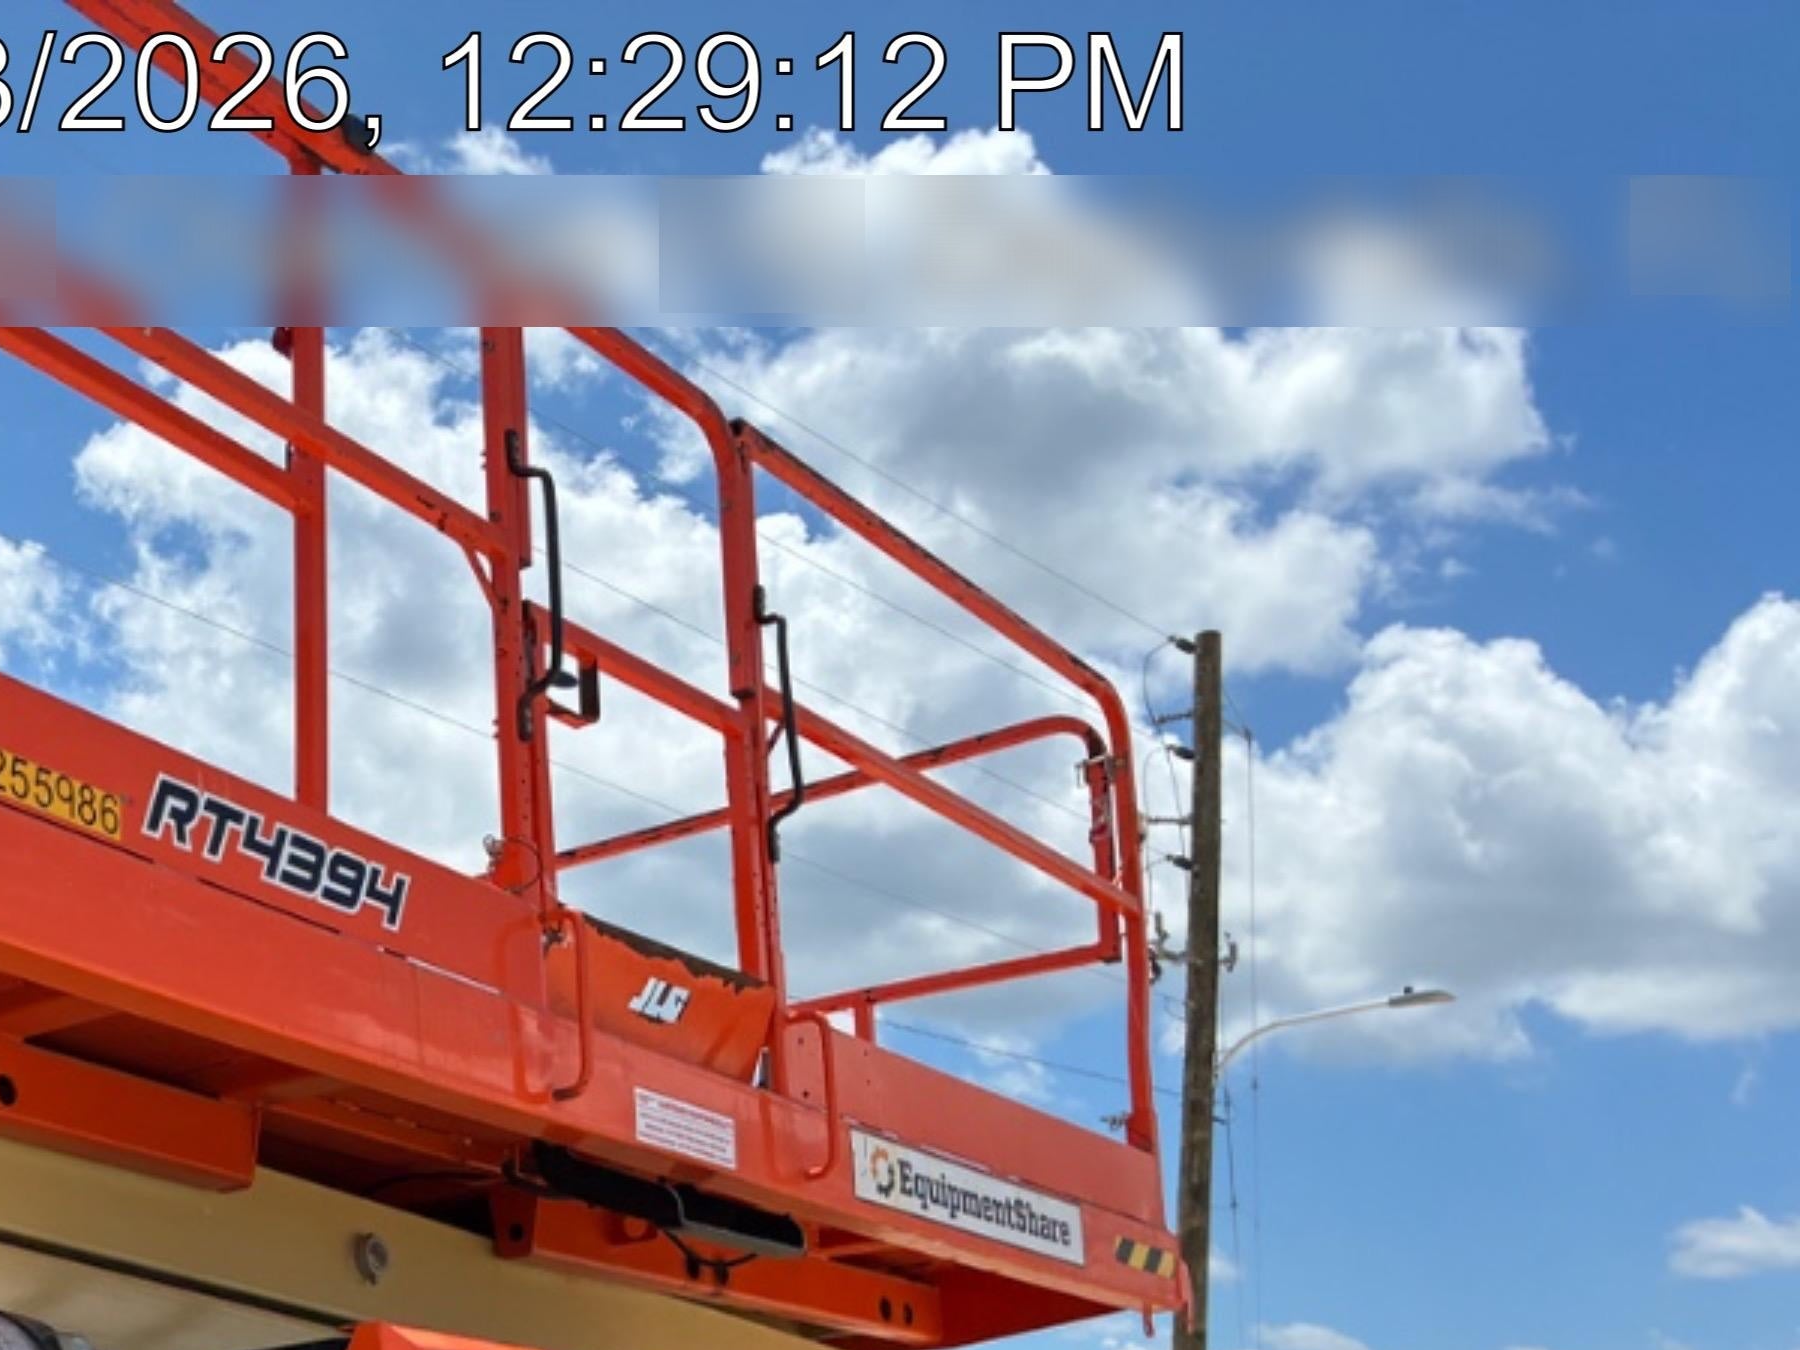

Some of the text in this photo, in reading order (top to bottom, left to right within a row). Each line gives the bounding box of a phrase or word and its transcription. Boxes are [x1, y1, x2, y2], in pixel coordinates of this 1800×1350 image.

[142, 772, 410, 931] RT4394
[627, 976, 691, 1025] JLG
[897, 1157, 1072, 1247] EquipmentShare
